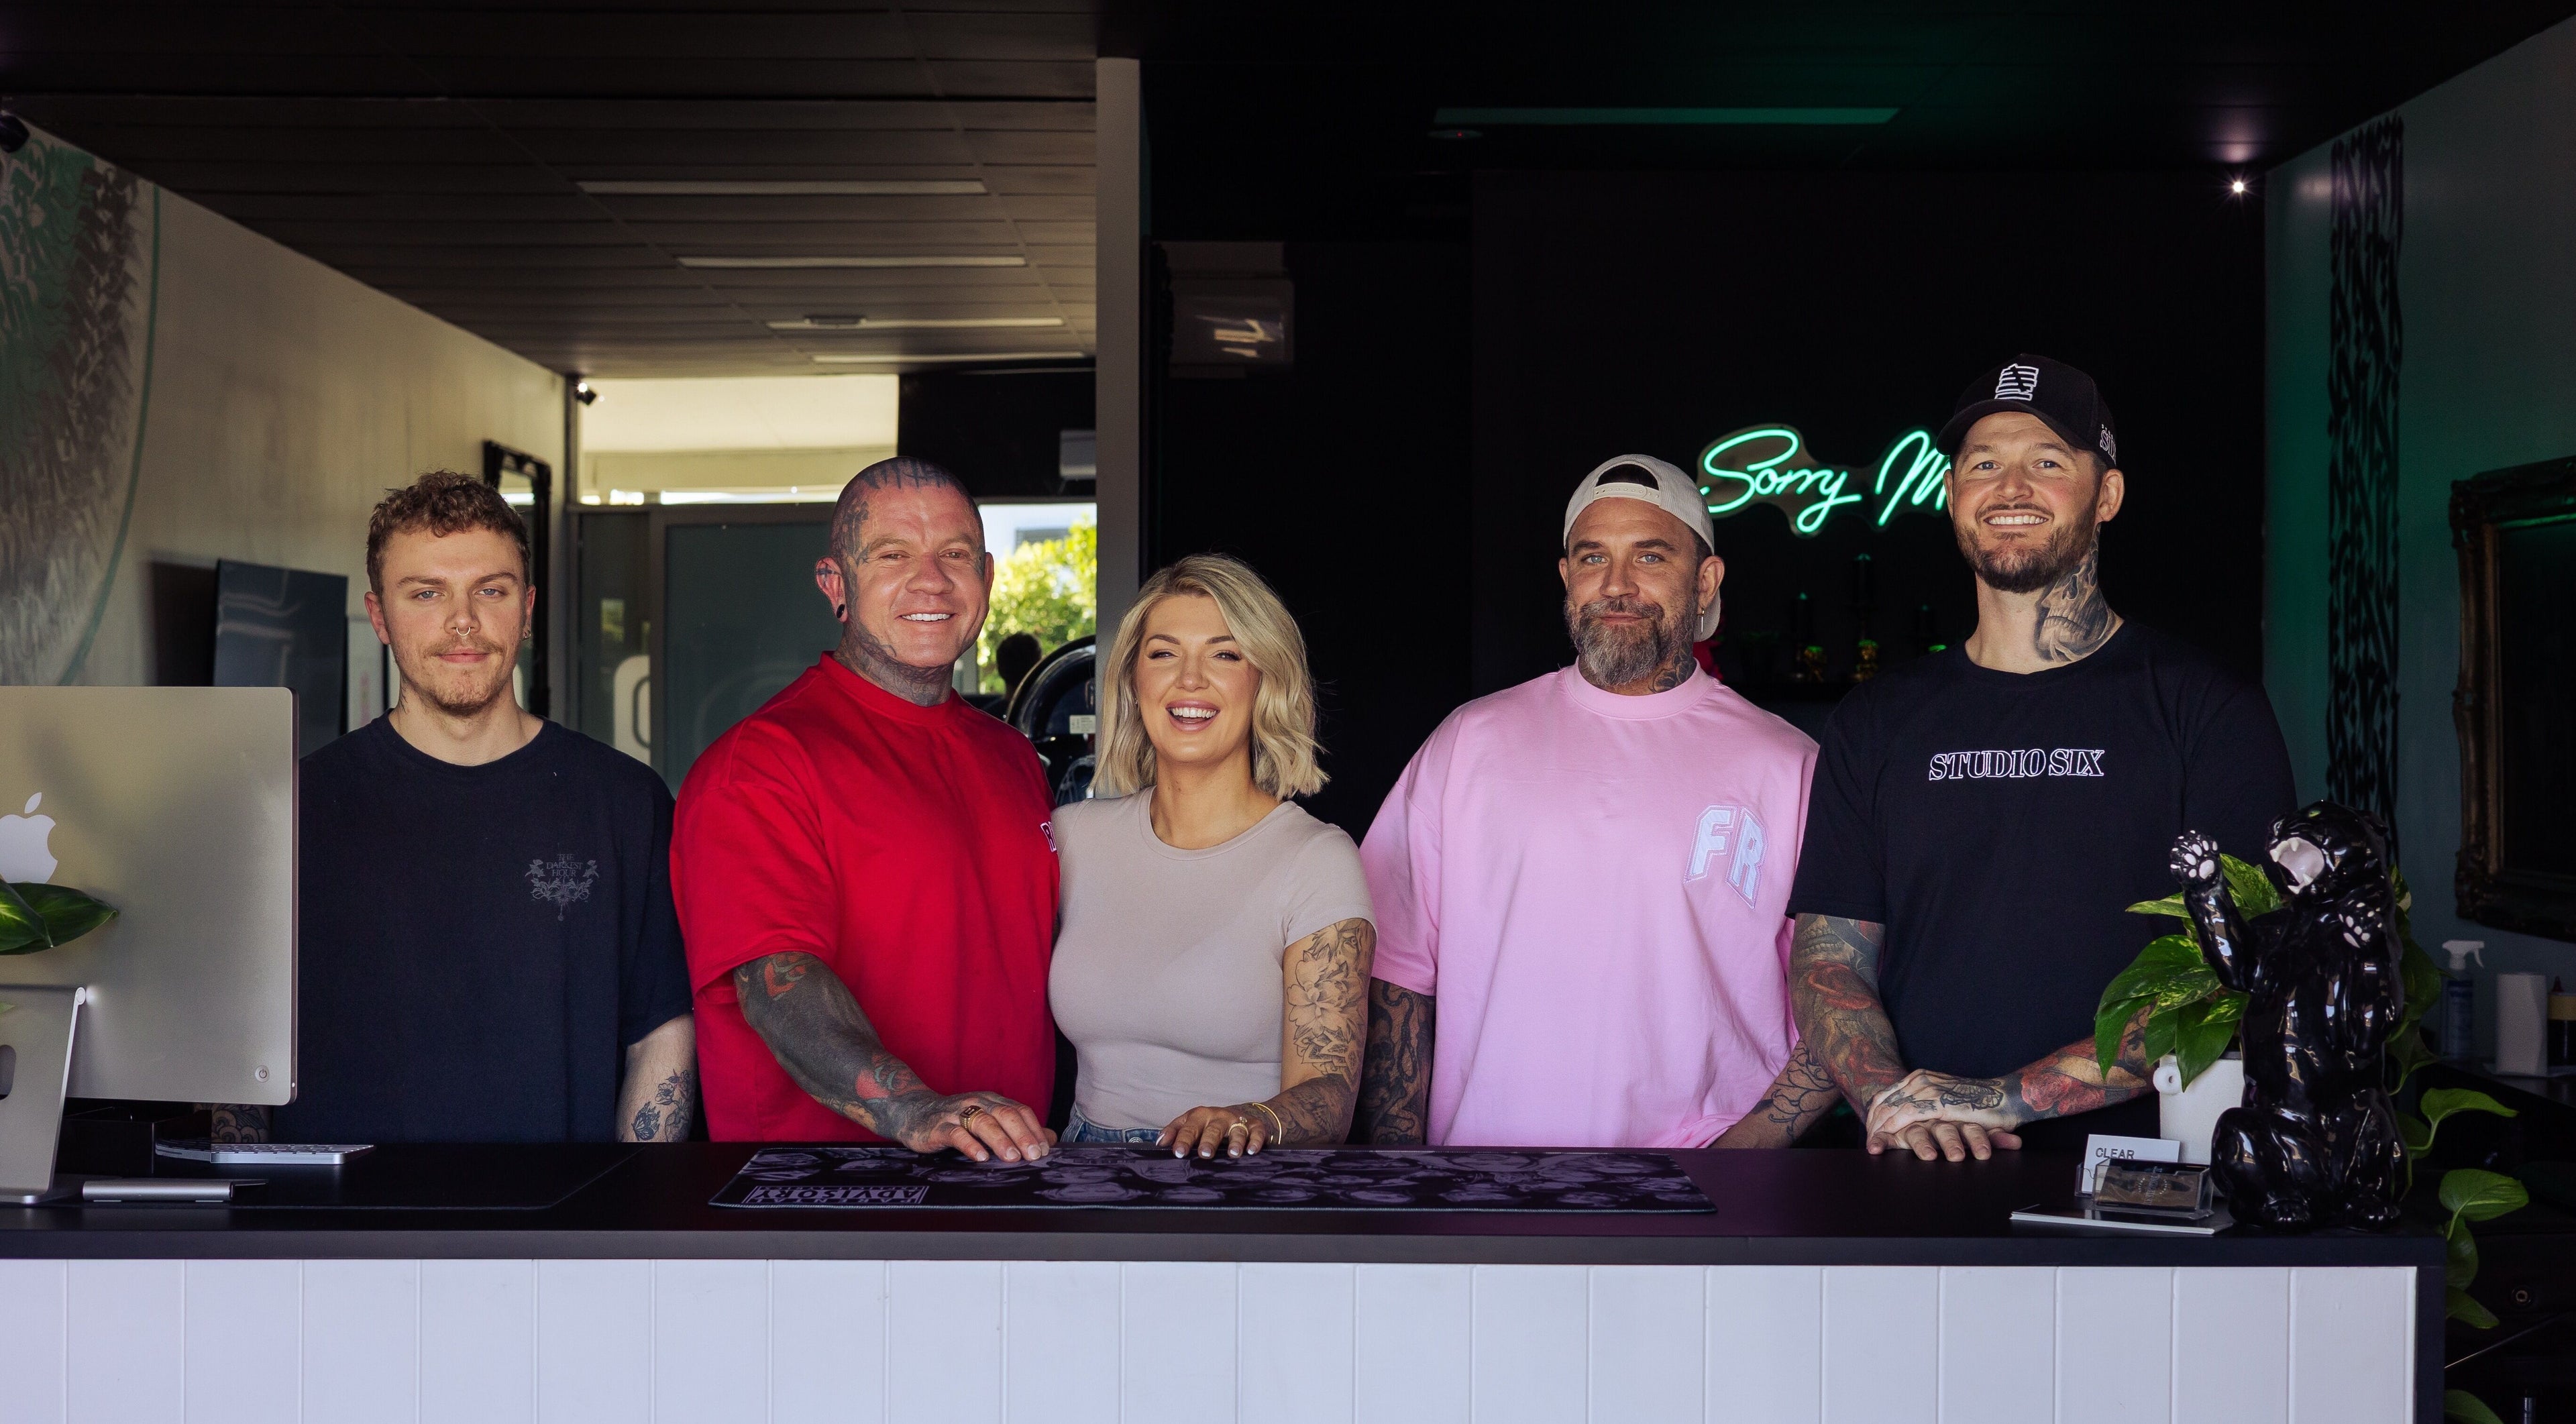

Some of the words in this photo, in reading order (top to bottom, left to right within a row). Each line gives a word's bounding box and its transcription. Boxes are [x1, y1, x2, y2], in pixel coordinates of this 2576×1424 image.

[1700, 429, 1863, 533] Sorry
[1929, 749, 2046, 781] STUDIO
[2049, 749, 2105, 776] SIX
[545, 862, 583, 870] DARKEST
[1683, 804, 1770, 910] FR
[2096, 1147, 2135, 1160] CLEAR
[753, 1190, 920, 1199] ADVISORY
